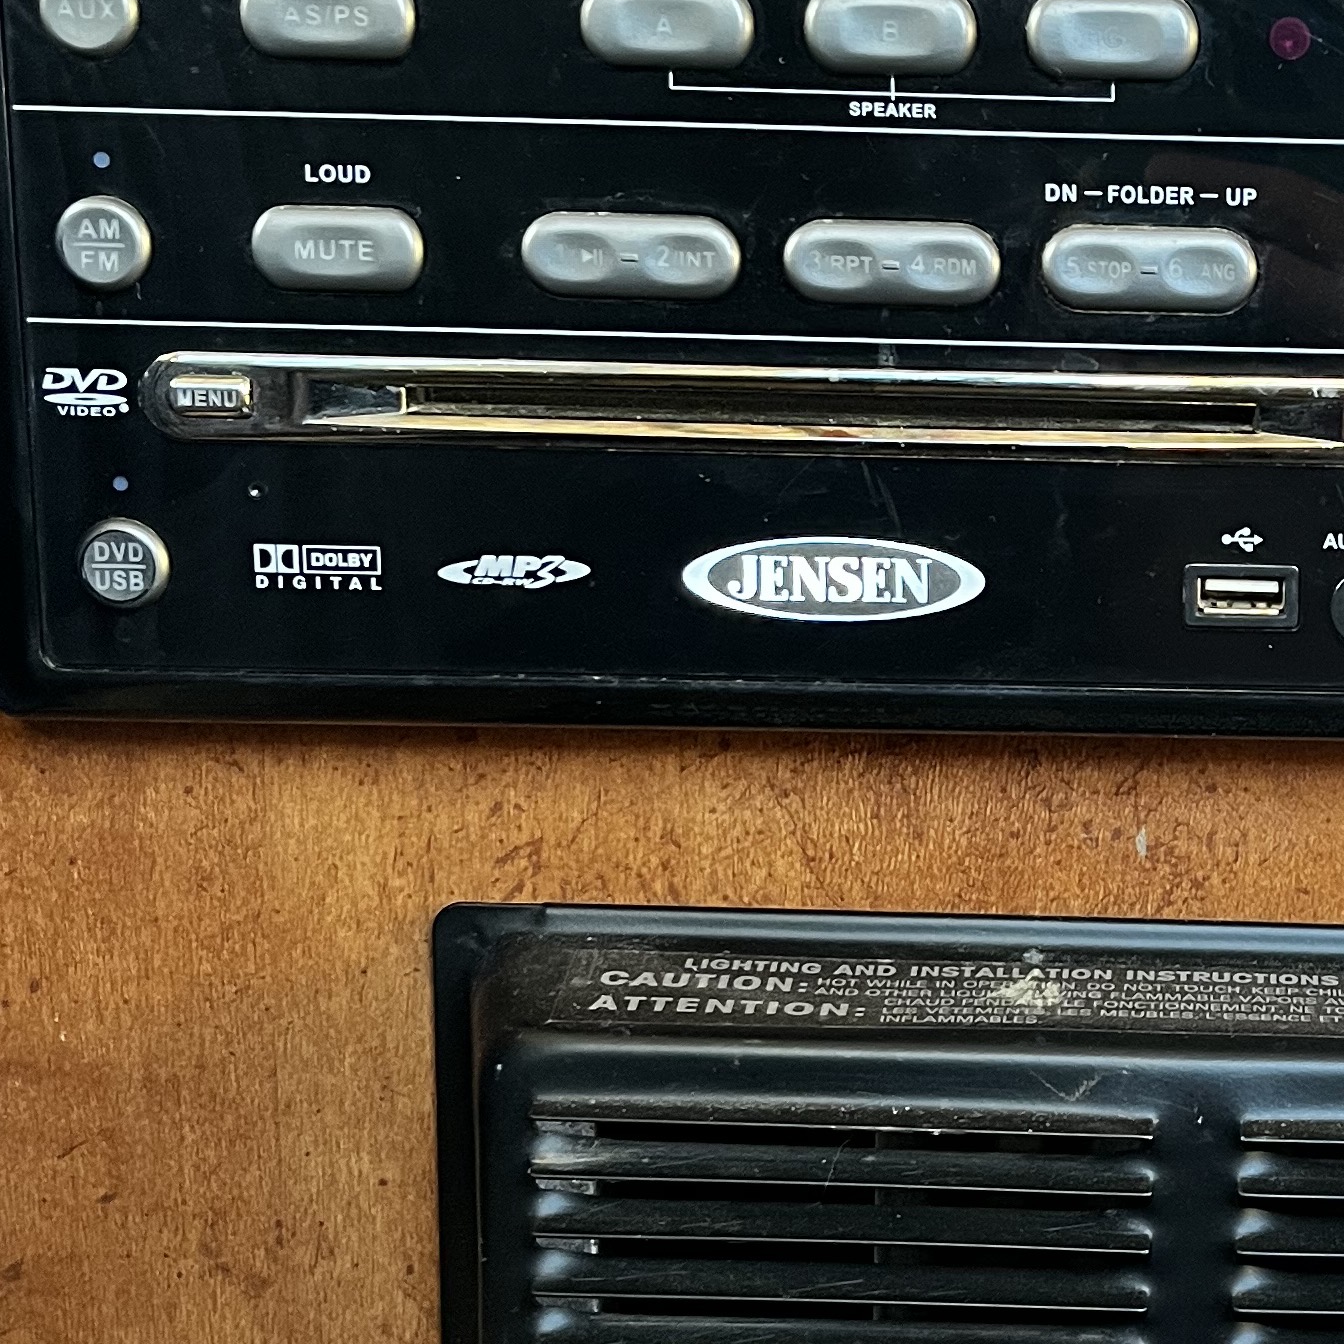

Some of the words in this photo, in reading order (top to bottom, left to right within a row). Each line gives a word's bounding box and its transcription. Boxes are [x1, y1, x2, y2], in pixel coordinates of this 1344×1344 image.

[283, 3, 370, 28] AS/PS
[655, 15, 674, 36] A
[881, 20, 899, 43] B
[848, 101, 937, 121] SPEAKER
[304, 163, 372, 184] LOUD
[1044, 183, 1078, 203] DN
[1106, 185, 1195, 206] FOLDER
[1225, 188, 1258, 207] UP
[78, 217, 121, 241] AM
[80, 251, 120, 274] FM
[293, 240, 376, 263] MUTE
[829, 255, 873, 274] RPT
[933, 257, 977, 277] RDM
[41, 367, 128, 393] DVD
[176, 389, 238, 408] MENU
[57, 405, 117, 417] VIDEO
[93, 540, 144, 563] DVD
[310, 552, 373, 568] DOLBY
[95, 570, 145, 592] USB
[473, 554, 566, 589] MP3
[727, 554, 933, 605] JENSEN
[255, 575, 383, 591] DIGITAL
[600, 970, 809, 993] CAUTION:
[684, 957, 822, 975] LIGHTING
[832, 964, 898, 977] AND
[909, 965, 1113, 981] INSTALLATION
[1125, 969, 1340, 987] INSTRUCTIONS
[814, 987, 860, 996] AND
[863, 988, 933, 998] OTHER
[1110, 991, 1232, 1002] FLAMMABLE
[1238, 994, 1318, 1005] VAPORS
[816, 977, 859, 987] HOT
[866, 979, 928, 989] WHILE
[935, 979, 956, 989] IN
[1086, 982, 1116, 991] DO
[1122, 983, 1165, 992] NOT
[1251, 986, 1300, 996] KEEP
[588, 994, 866, 1018] ATTENTION:
[883, 998, 956, 1007] CHAUD
[1289, 1004, 1315, 1015] NE
